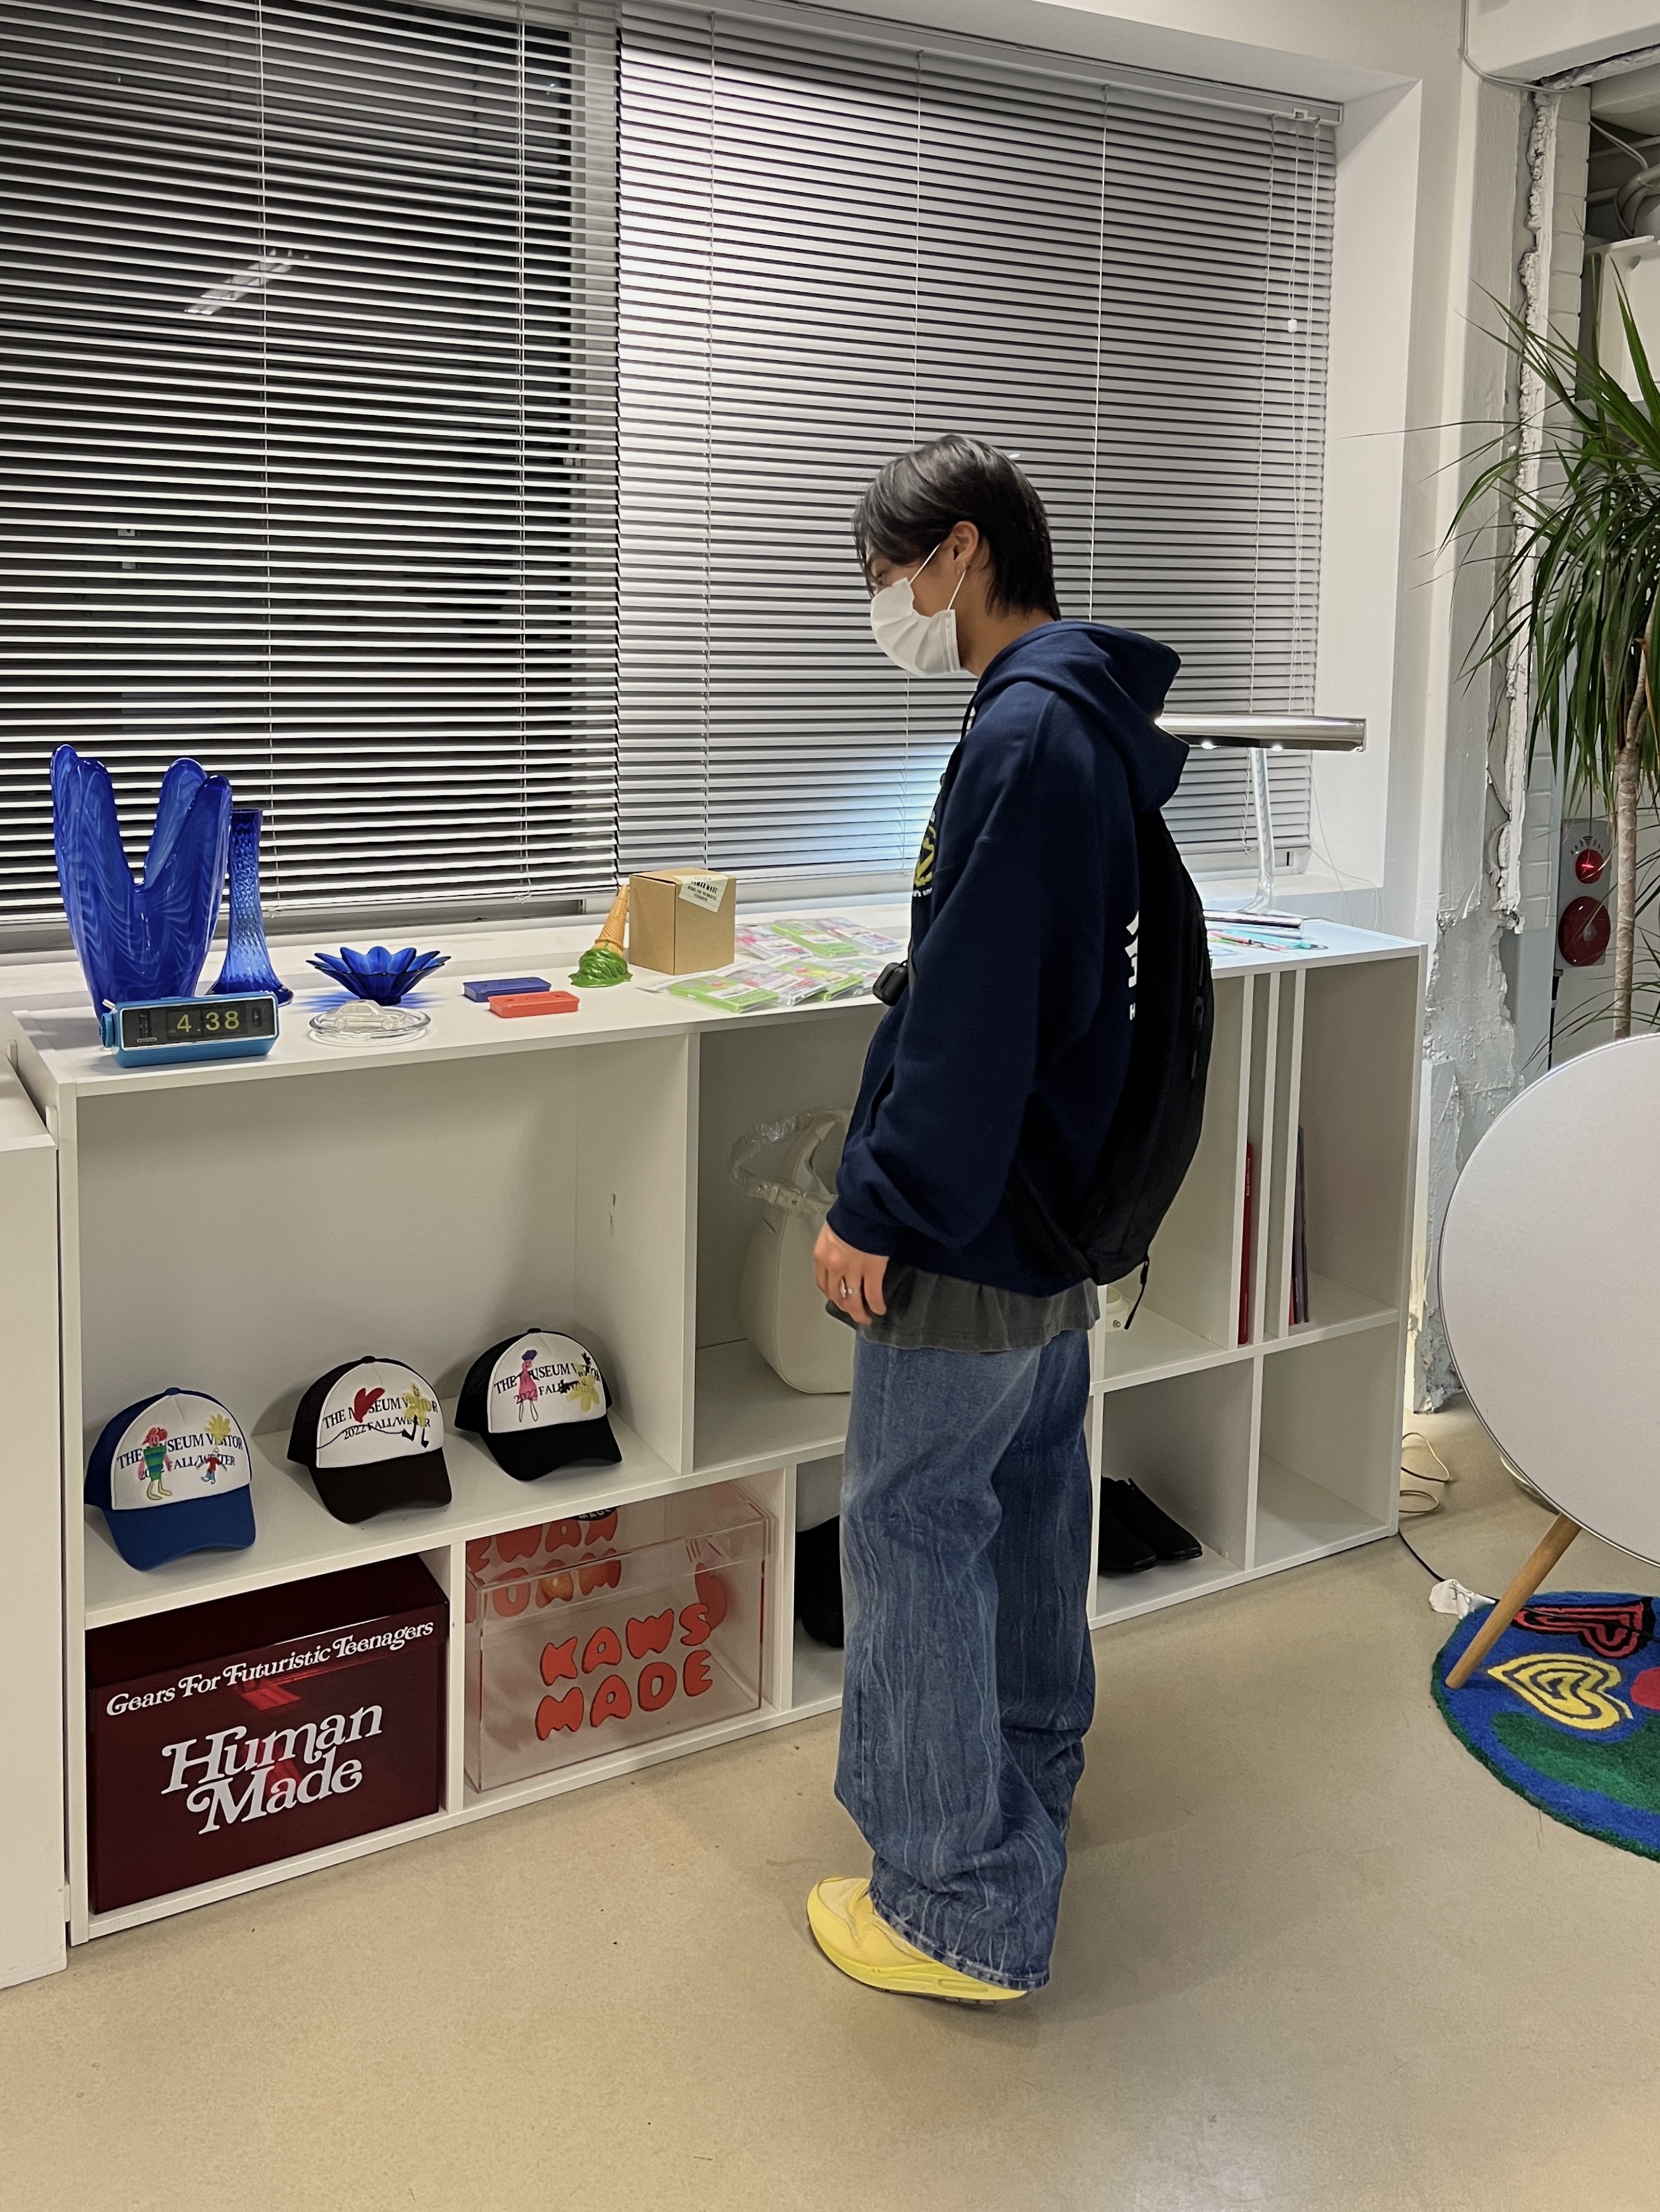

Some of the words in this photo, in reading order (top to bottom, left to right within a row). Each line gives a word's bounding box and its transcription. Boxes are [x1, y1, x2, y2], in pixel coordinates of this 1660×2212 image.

[323, 1409, 347, 1429] THE
[494, 1375, 518, 1395] THE
[117, 1448, 142, 1470] THE
[344, 1424, 366, 1440] 2022
[106, 1686, 176, 1717] Gears
[177, 1673, 222, 1699] For
[222, 1644, 332, 1688] Futuristic
[331, 1621, 435, 1659] Teenagers
[540, 1602, 712, 1687] KAWS
[534, 1649, 713, 1741] MADE
[161, 1704, 383, 1795] Human
[186, 1745, 363, 1835] Made
